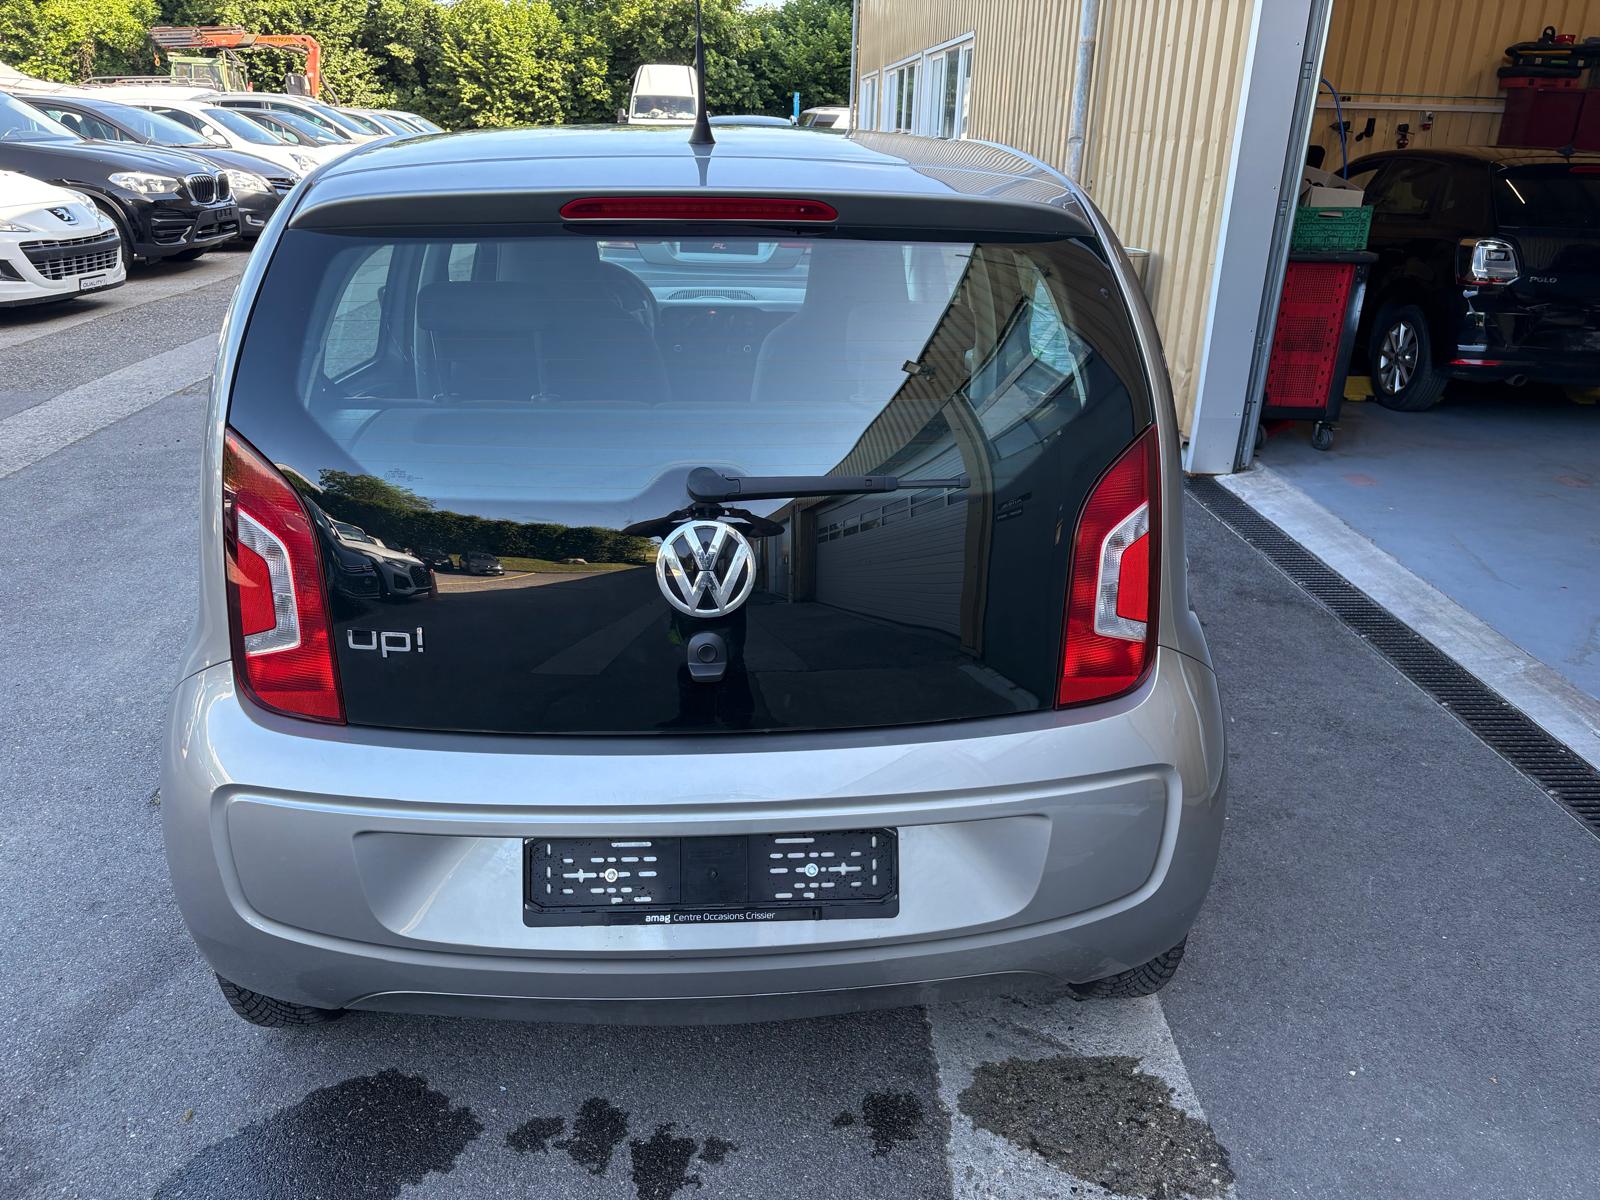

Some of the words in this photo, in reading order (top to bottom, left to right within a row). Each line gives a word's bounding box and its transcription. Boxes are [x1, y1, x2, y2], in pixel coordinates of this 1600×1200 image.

[346, 627, 424, 658] up!
[645, 914, 671, 924] amag
[673, 913, 702, 922] Centre
[703, 912, 745, 921] Occasions
[745, 911, 776, 920] Crissier
